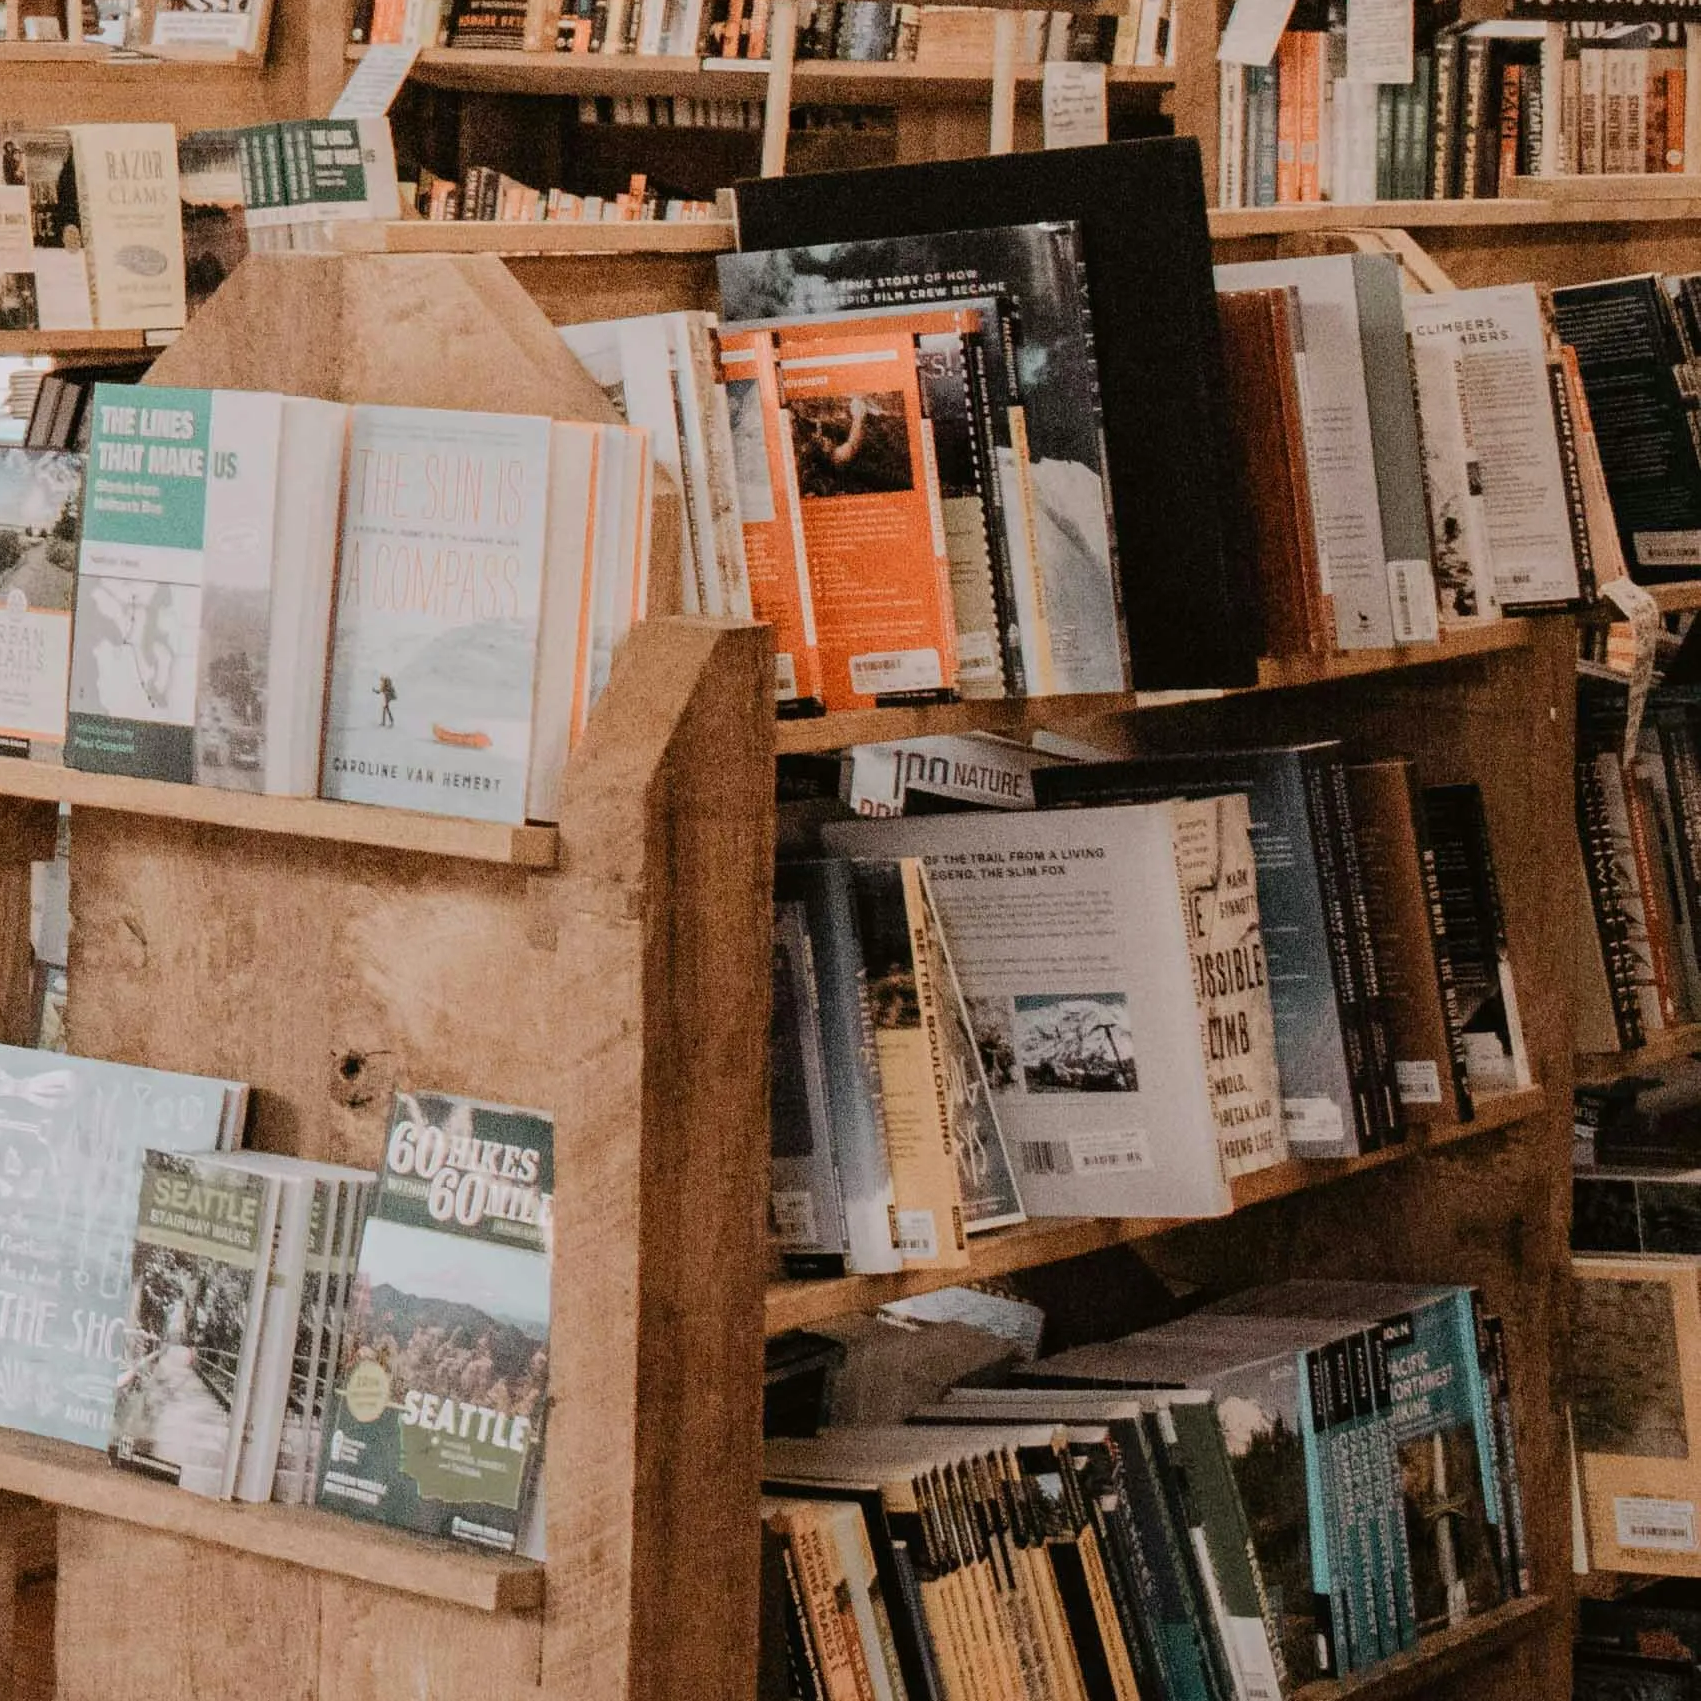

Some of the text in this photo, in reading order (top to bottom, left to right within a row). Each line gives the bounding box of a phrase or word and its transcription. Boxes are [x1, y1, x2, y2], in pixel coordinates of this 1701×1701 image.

[105, 149, 164, 182] RAZOR
[107, 185, 169, 206] CLAMS
[840, 269, 978, 291] TRUE STORY OF HOW
[873, 281, 1007, 302] FILM CREW BECAME
[100, 406, 195, 440] THE LINES
[97, 442, 238, 479] THAT MAKE US
[1553, 372, 1592, 571] MOUNTAINEERING
[359, 448, 525, 528] THE SUN IS
[344, 539, 522, 621] A COMPASS
[332, 756, 503, 793] CAROLINE VAN HEMERT
[953, 761, 1025, 799] NATURE
[944, 854, 966, 865] THE
[970, 852, 1005, 864] TRAIL
[1009, 851, 1045, 862] FROM
[1048, 850, 1058, 860] A
[1061, 848, 1105, 860] LIVING
[980, 865, 1066, 879] THE SLIM FOX
[1226, 869, 1249, 888] MARK
[914, 927, 953, 1157] BETTER BOULDERING
[387, 1120, 540, 1184] 60 HIKES
[153, 1177, 259, 1227] SEATTLE
[428, 1167, 484, 1227] 60
[150, 1209, 252, 1246] STAIRWAY WALKS
[403, 1388, 532, 1452] SEATTLE
